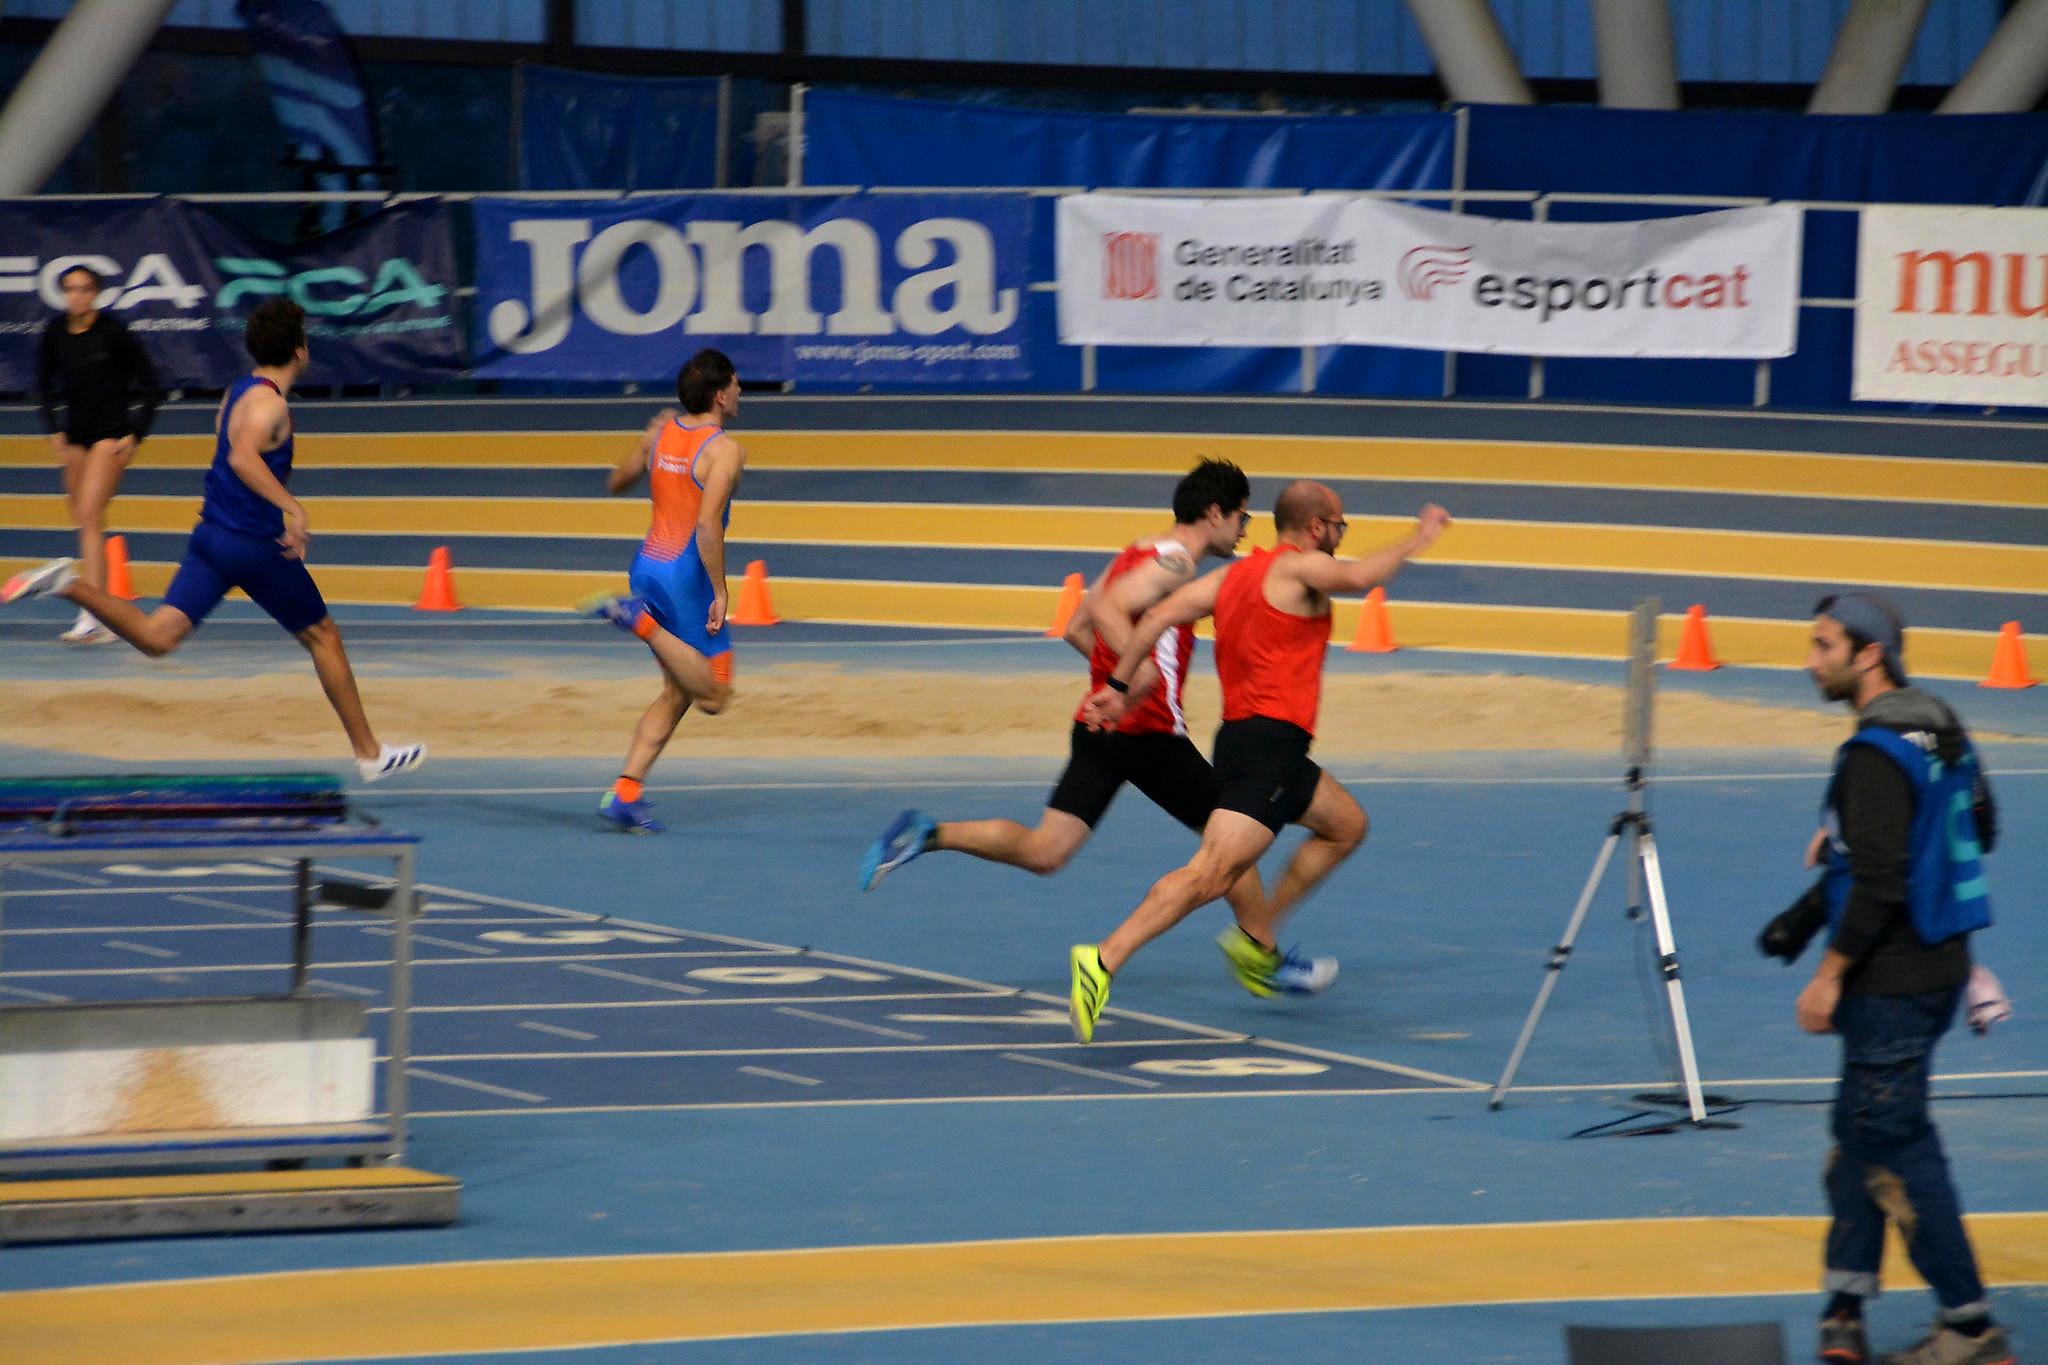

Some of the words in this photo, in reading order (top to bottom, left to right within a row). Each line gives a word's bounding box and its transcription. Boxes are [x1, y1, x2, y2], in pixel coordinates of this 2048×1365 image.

[1174, 238, 1356, 266] Generalitat
[214, 257, 448, 316] FCA
[488, 218, 1018, 354] Joma
[1174, 274, 1216, 302] de
[1225, 273, 1385, 307] Catalunya
[1474, 264, 1751, 323] esportcat
[1129, 1056, 1331, 1077] 8
